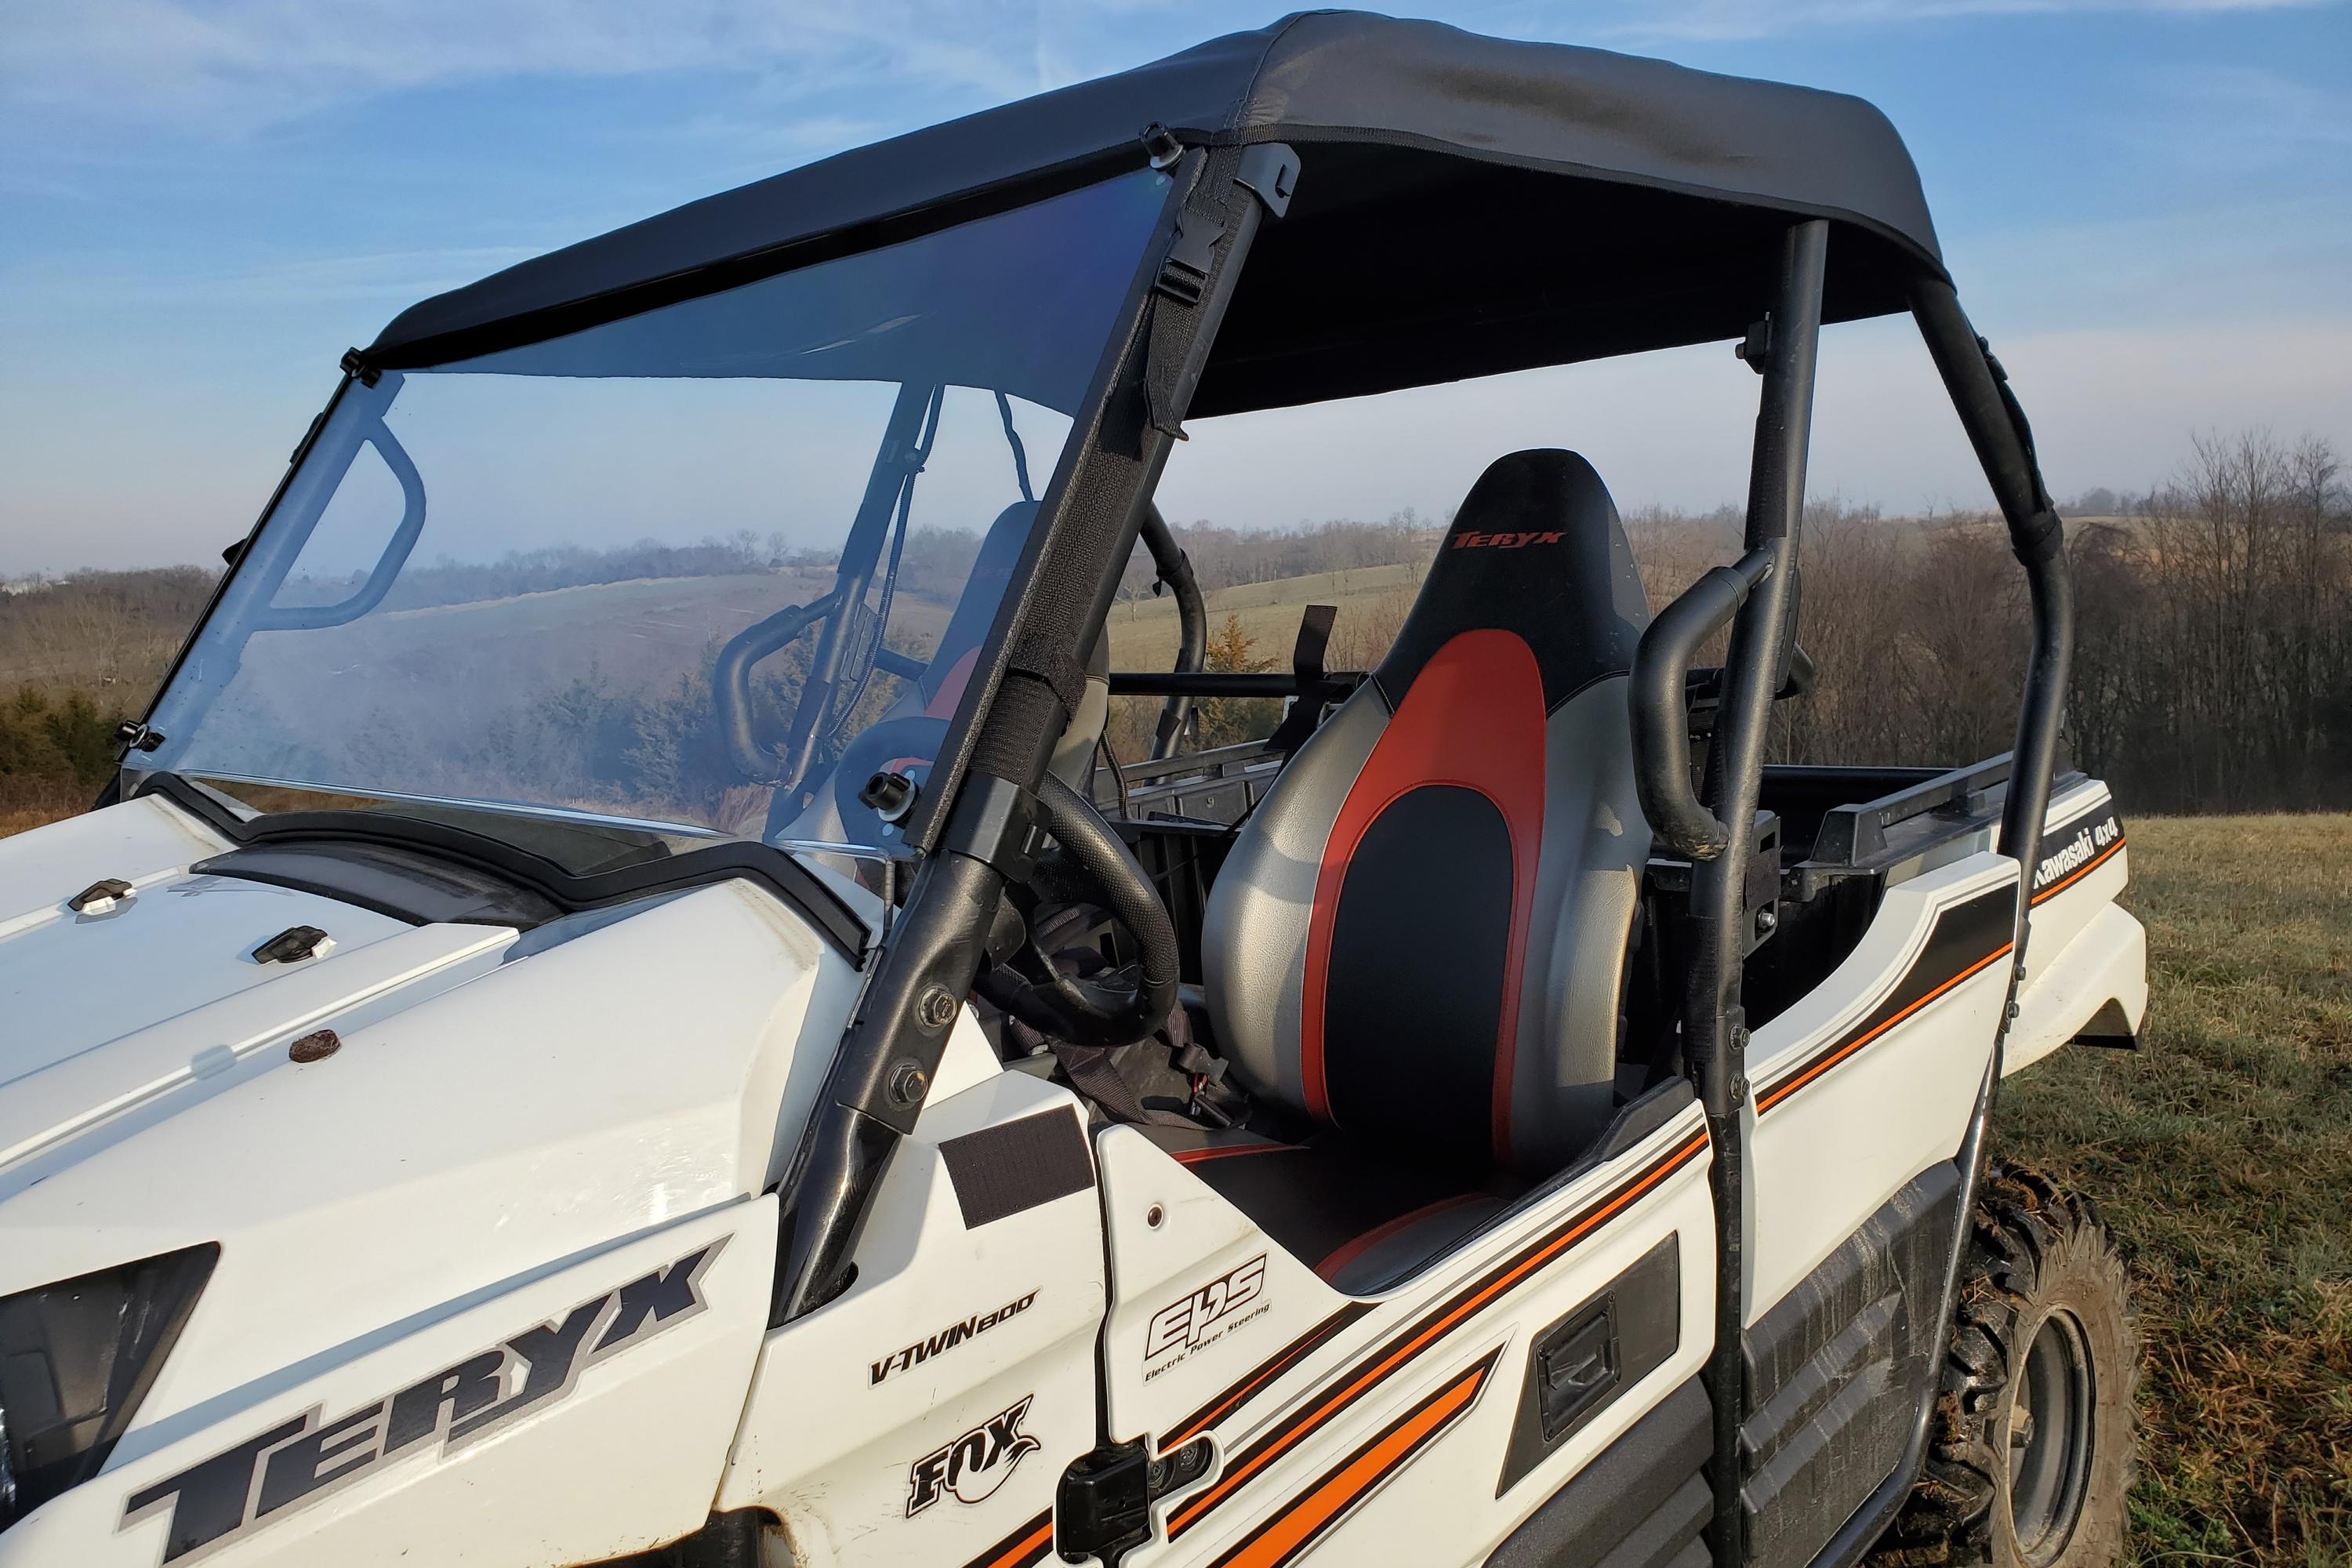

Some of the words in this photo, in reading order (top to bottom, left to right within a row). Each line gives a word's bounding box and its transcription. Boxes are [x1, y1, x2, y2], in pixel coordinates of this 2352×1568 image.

[1452, 530, 1566, 549] TERYX
[2095, 816, 2118, 846] 4x4
[1145, 1252, 1267, 1361] EPS
[1145, 1352, 1185, 1381] Electric
[1190, 1330, 1223, 1355] Power
[1228, 1302, 1270, 1333] Steering
[116, 1233, 735, 1566] TERYX
[906, 1393, 1041, 1519] FOX
